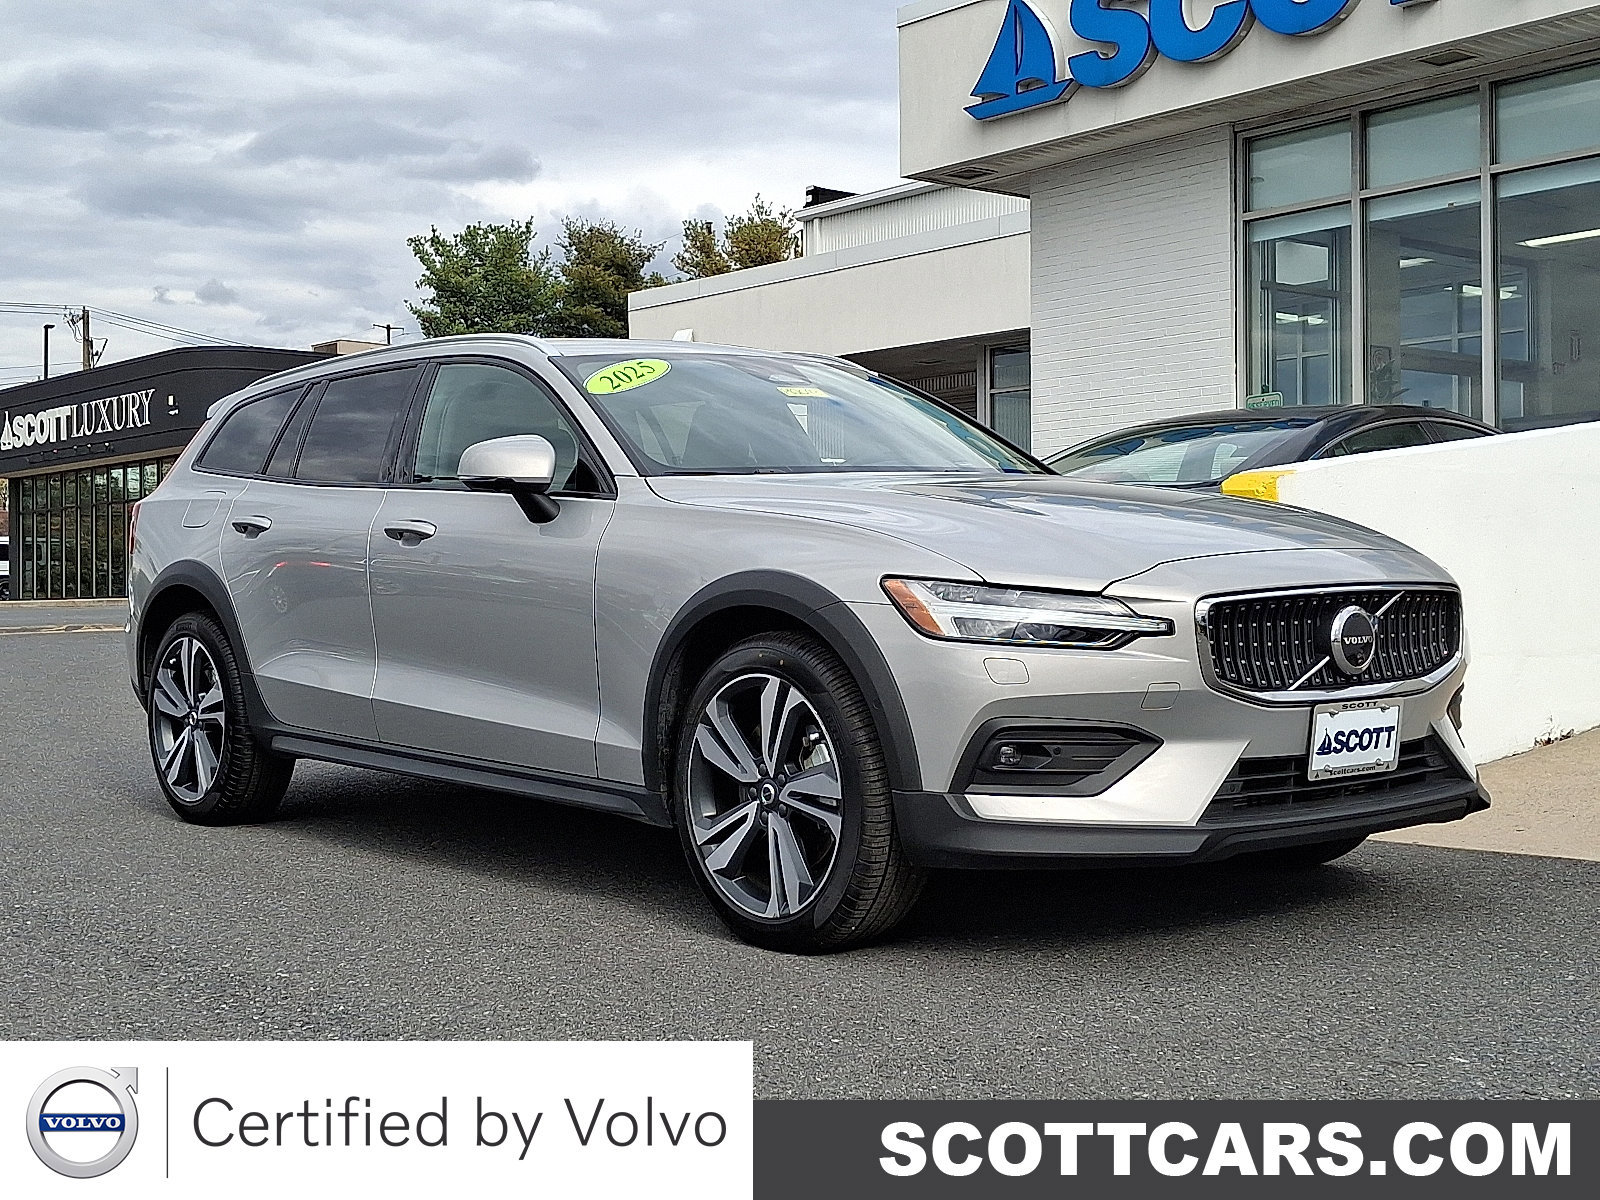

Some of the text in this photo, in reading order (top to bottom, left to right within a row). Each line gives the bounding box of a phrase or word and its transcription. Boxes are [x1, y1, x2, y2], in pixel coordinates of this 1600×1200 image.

[600, 362, 655, 390] 2025
[13, 389, 156, 448] SCOTT LUXURY
[1343, 636, 1373, 644] VOLVO
[1342, 701, 1378, 709] SCOTT
[1332, 725, 1395, 754] SCOTT
